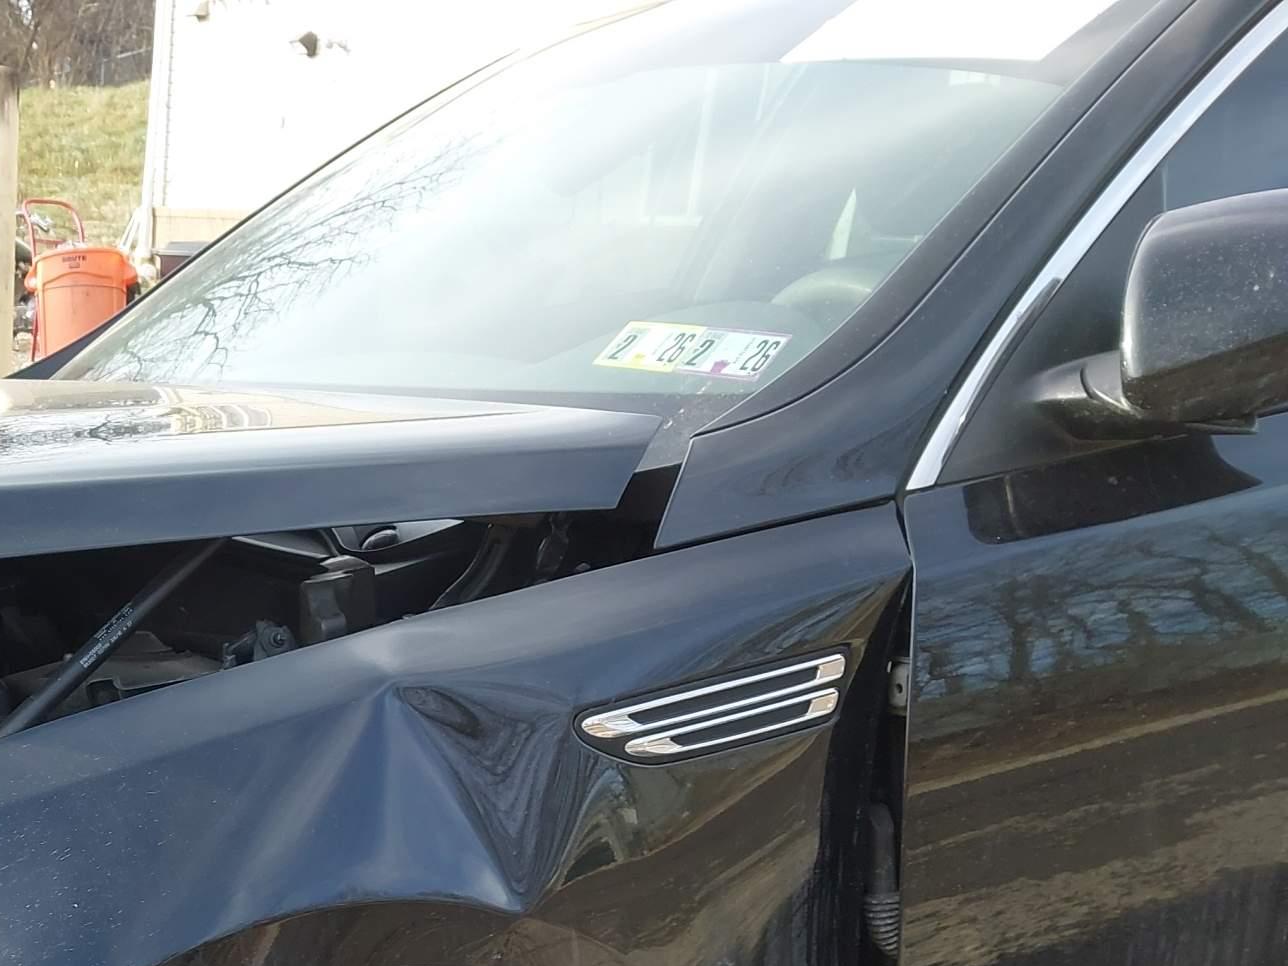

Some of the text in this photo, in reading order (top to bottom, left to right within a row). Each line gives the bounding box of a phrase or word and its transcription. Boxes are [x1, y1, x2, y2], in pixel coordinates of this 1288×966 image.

[607, 332, 697, 364] 2 26
[684, 338, 781, 373] 2 26
